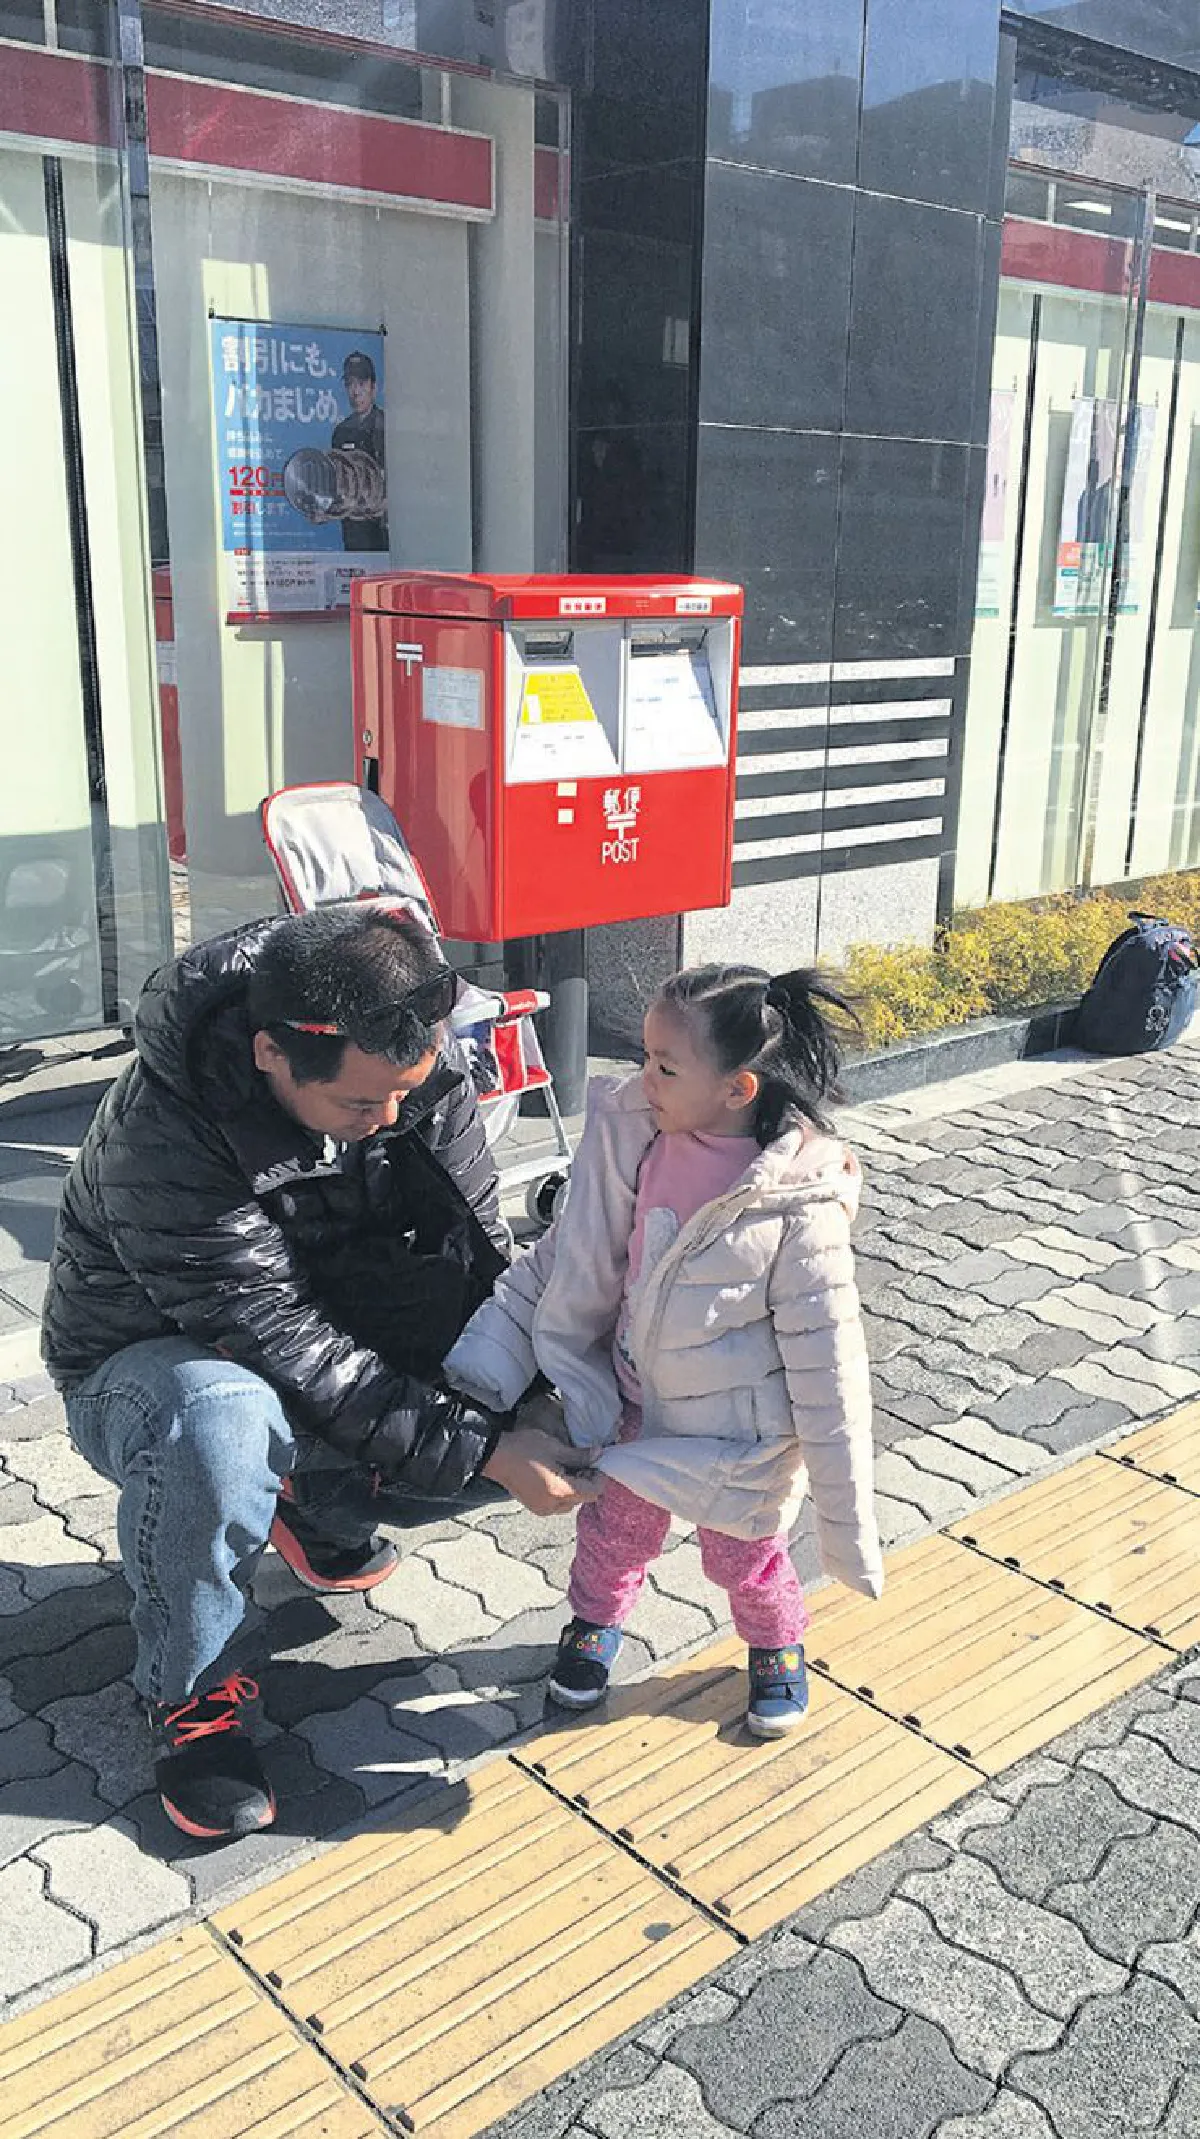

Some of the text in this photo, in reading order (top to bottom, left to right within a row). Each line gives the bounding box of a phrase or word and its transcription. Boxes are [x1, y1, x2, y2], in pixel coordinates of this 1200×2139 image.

[221, 336, 337, 377] 割引にも、
[602, 838, 640, 864] POST
